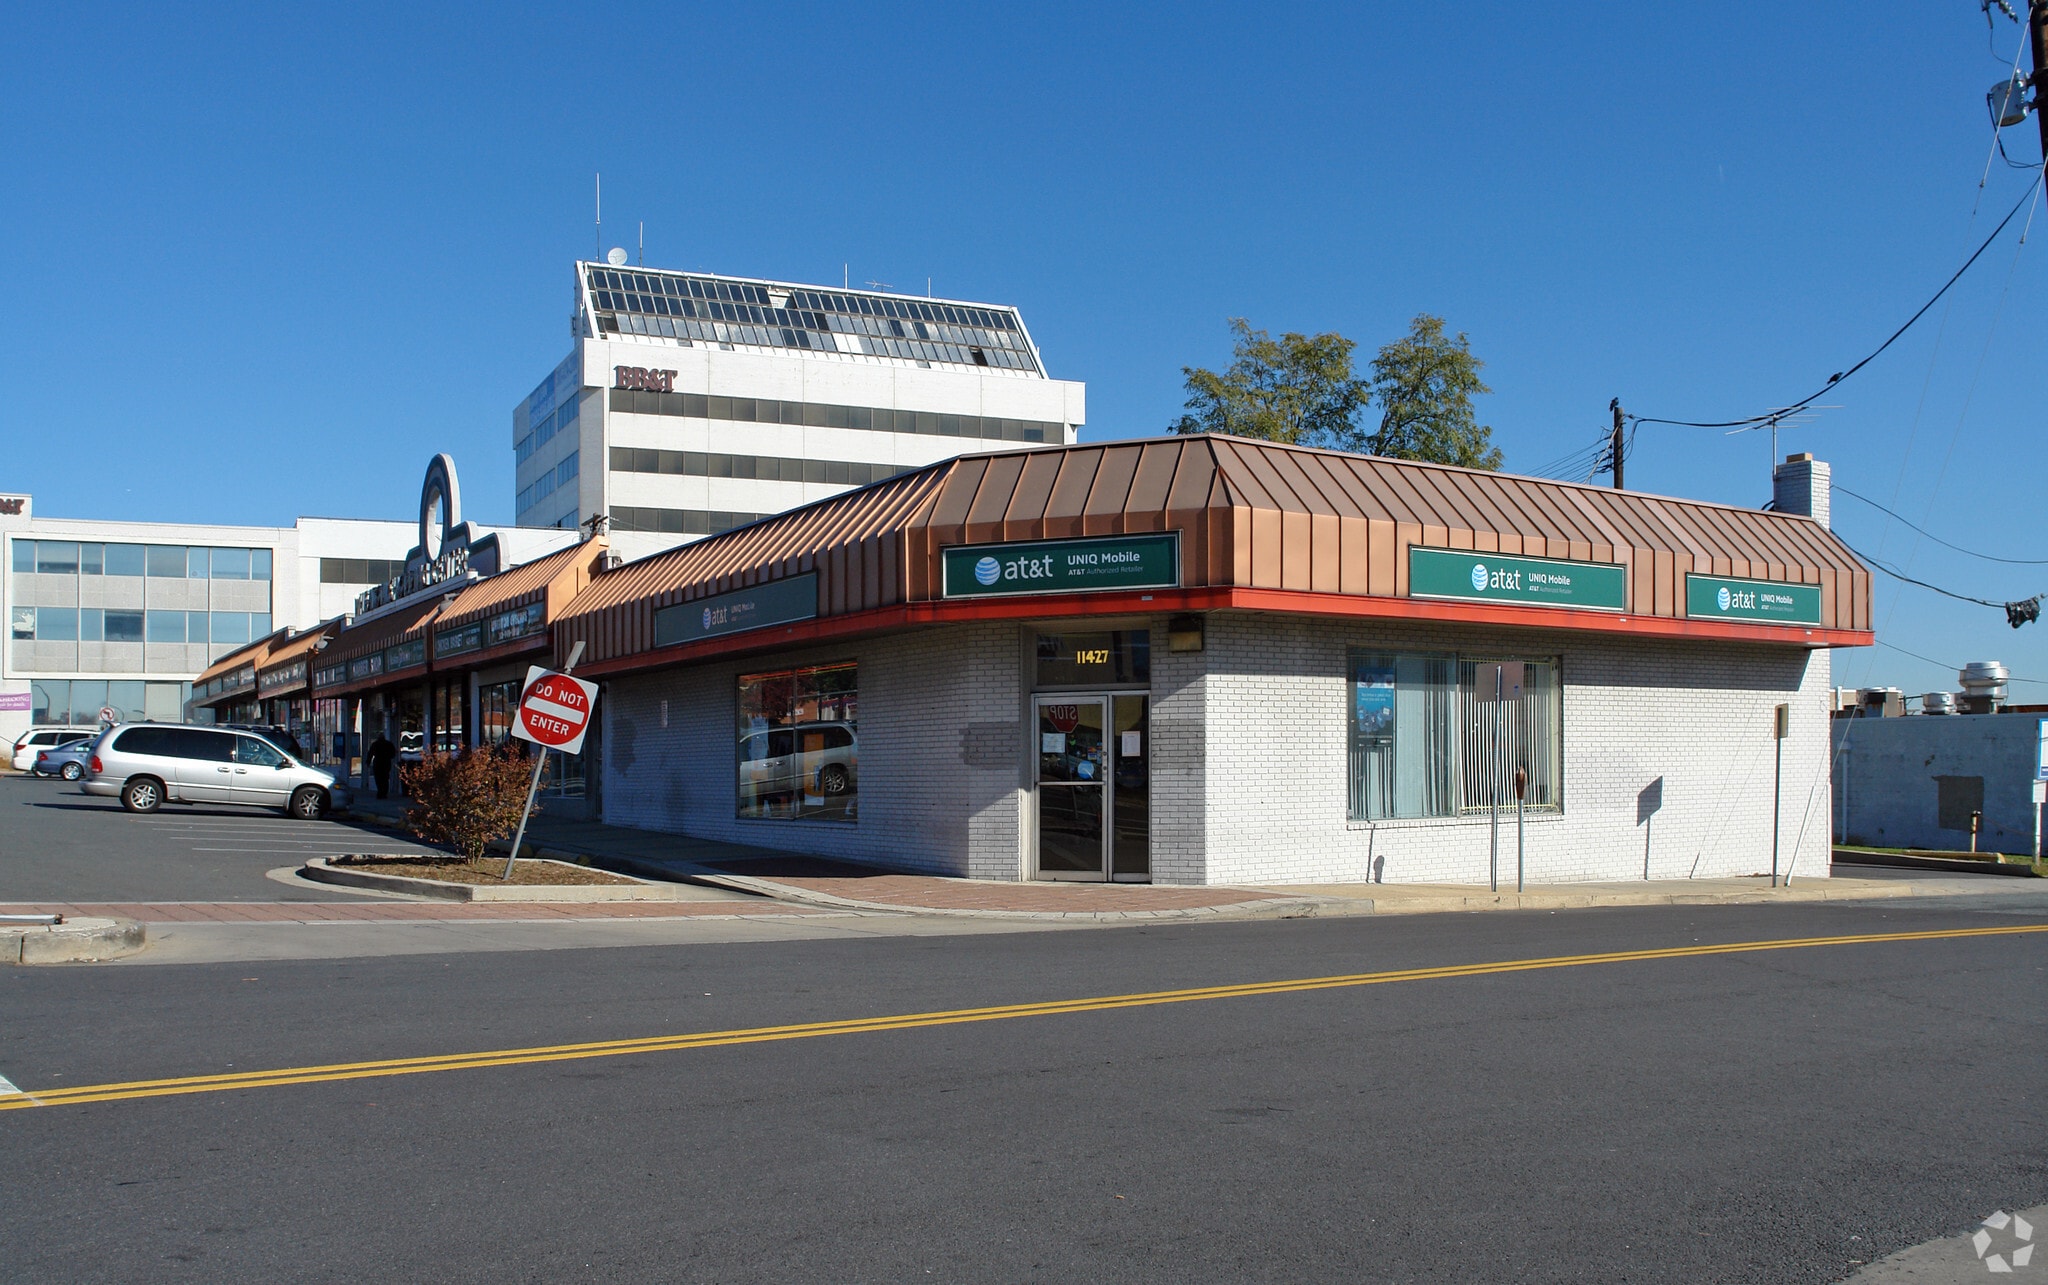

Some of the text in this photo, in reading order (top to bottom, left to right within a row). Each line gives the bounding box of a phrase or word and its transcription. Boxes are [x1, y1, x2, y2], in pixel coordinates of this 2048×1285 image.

[613, 365, 678, 393] BB&T
[1004, 555, 1054, 580] at&t
[1067, 551, 1141, 566] UNIQ Mobile
[1490, 568, 1521, 591] at&t
[1528, 572, 1571, 586] UNIQ Mobile
[1731, 590, 1756, 609] at&t
[1760, 593, 1793, 604] UNIQ Mobile
[711, 605, 728, 625] at&t
[1076, 650, 1109, 664] 11427
[535, 682, 584, 707] DO NOT
[530, 714, 570, 736] ENTER
